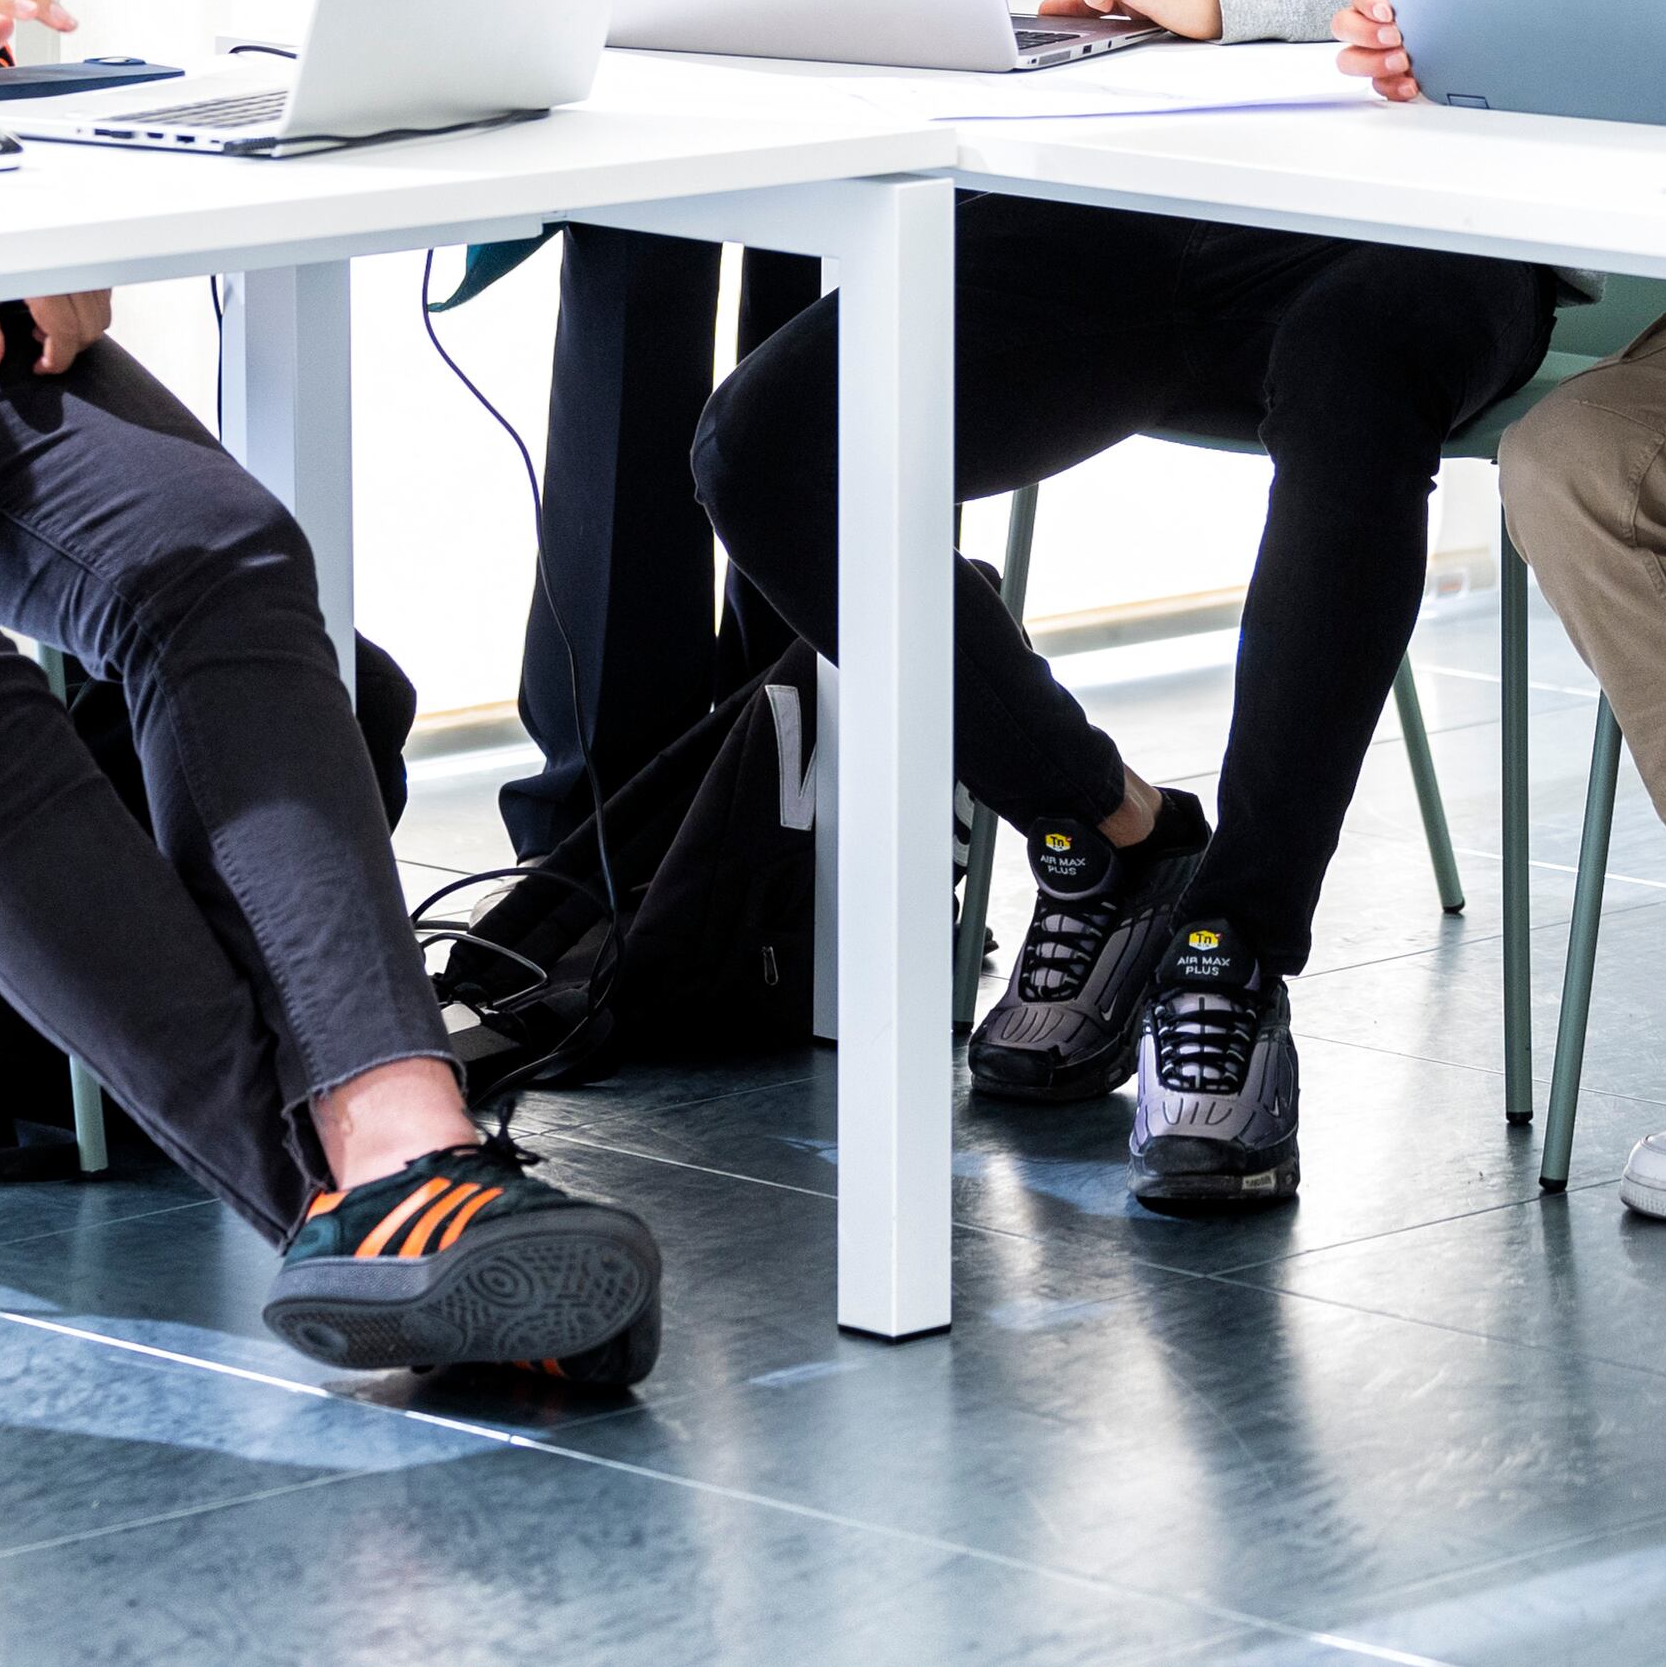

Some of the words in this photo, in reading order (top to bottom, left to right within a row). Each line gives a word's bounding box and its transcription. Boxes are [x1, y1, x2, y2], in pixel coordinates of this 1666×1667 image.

[1040, 854, 1057, 865] AIR
[1059, 857, 1086, 867] MAX
[1047, 864, 1077, 876] PLUS
[1176, 955, 1198, 966] AIR
[1201, 956, 1231, 967] MAX
[1185, 965, 1219, 976] PLUS
